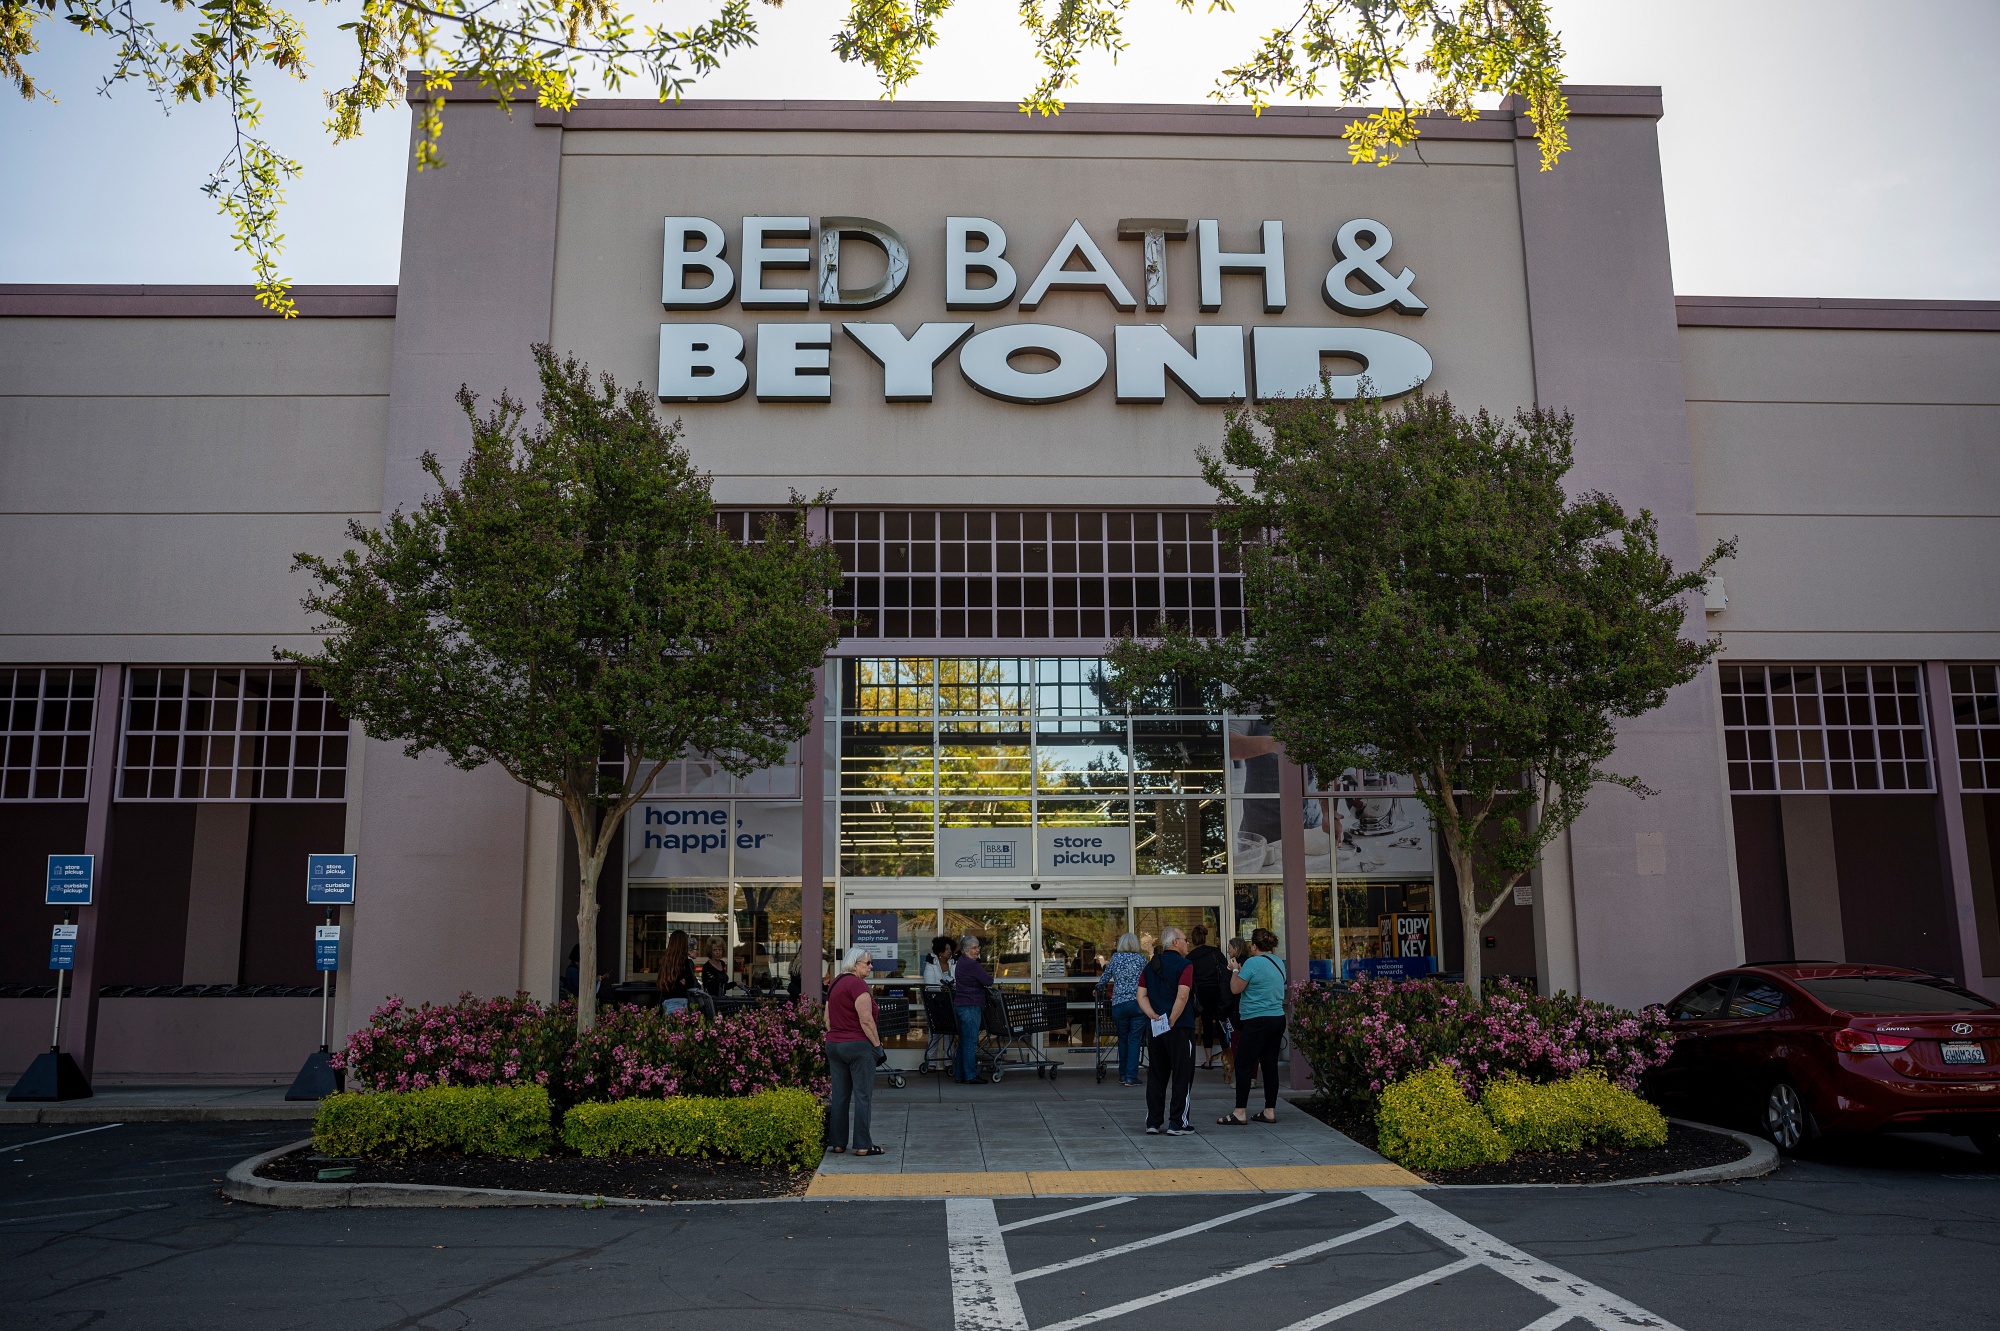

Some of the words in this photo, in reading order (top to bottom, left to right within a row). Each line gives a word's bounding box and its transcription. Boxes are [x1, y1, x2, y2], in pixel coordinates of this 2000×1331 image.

[661, 216, 909, 311] BED
[945, 216, 1288, 314] BATH
[1321, 218, 1429, 317] &
[658, 321, 1434, 405] BEYOND
[986, 844, 1010, 853] BB&B
[1053, 836, 1103, 848] store
[1053, 851, 1116, 867] pickup
[1206, 856, 1223, 869] 15
[54, 927, 62, 937] 2
[318, 929, 323, 938] 1
[1398, 918, 1429, 935] COPY
[1402, 940, 1426, 957] KEY
